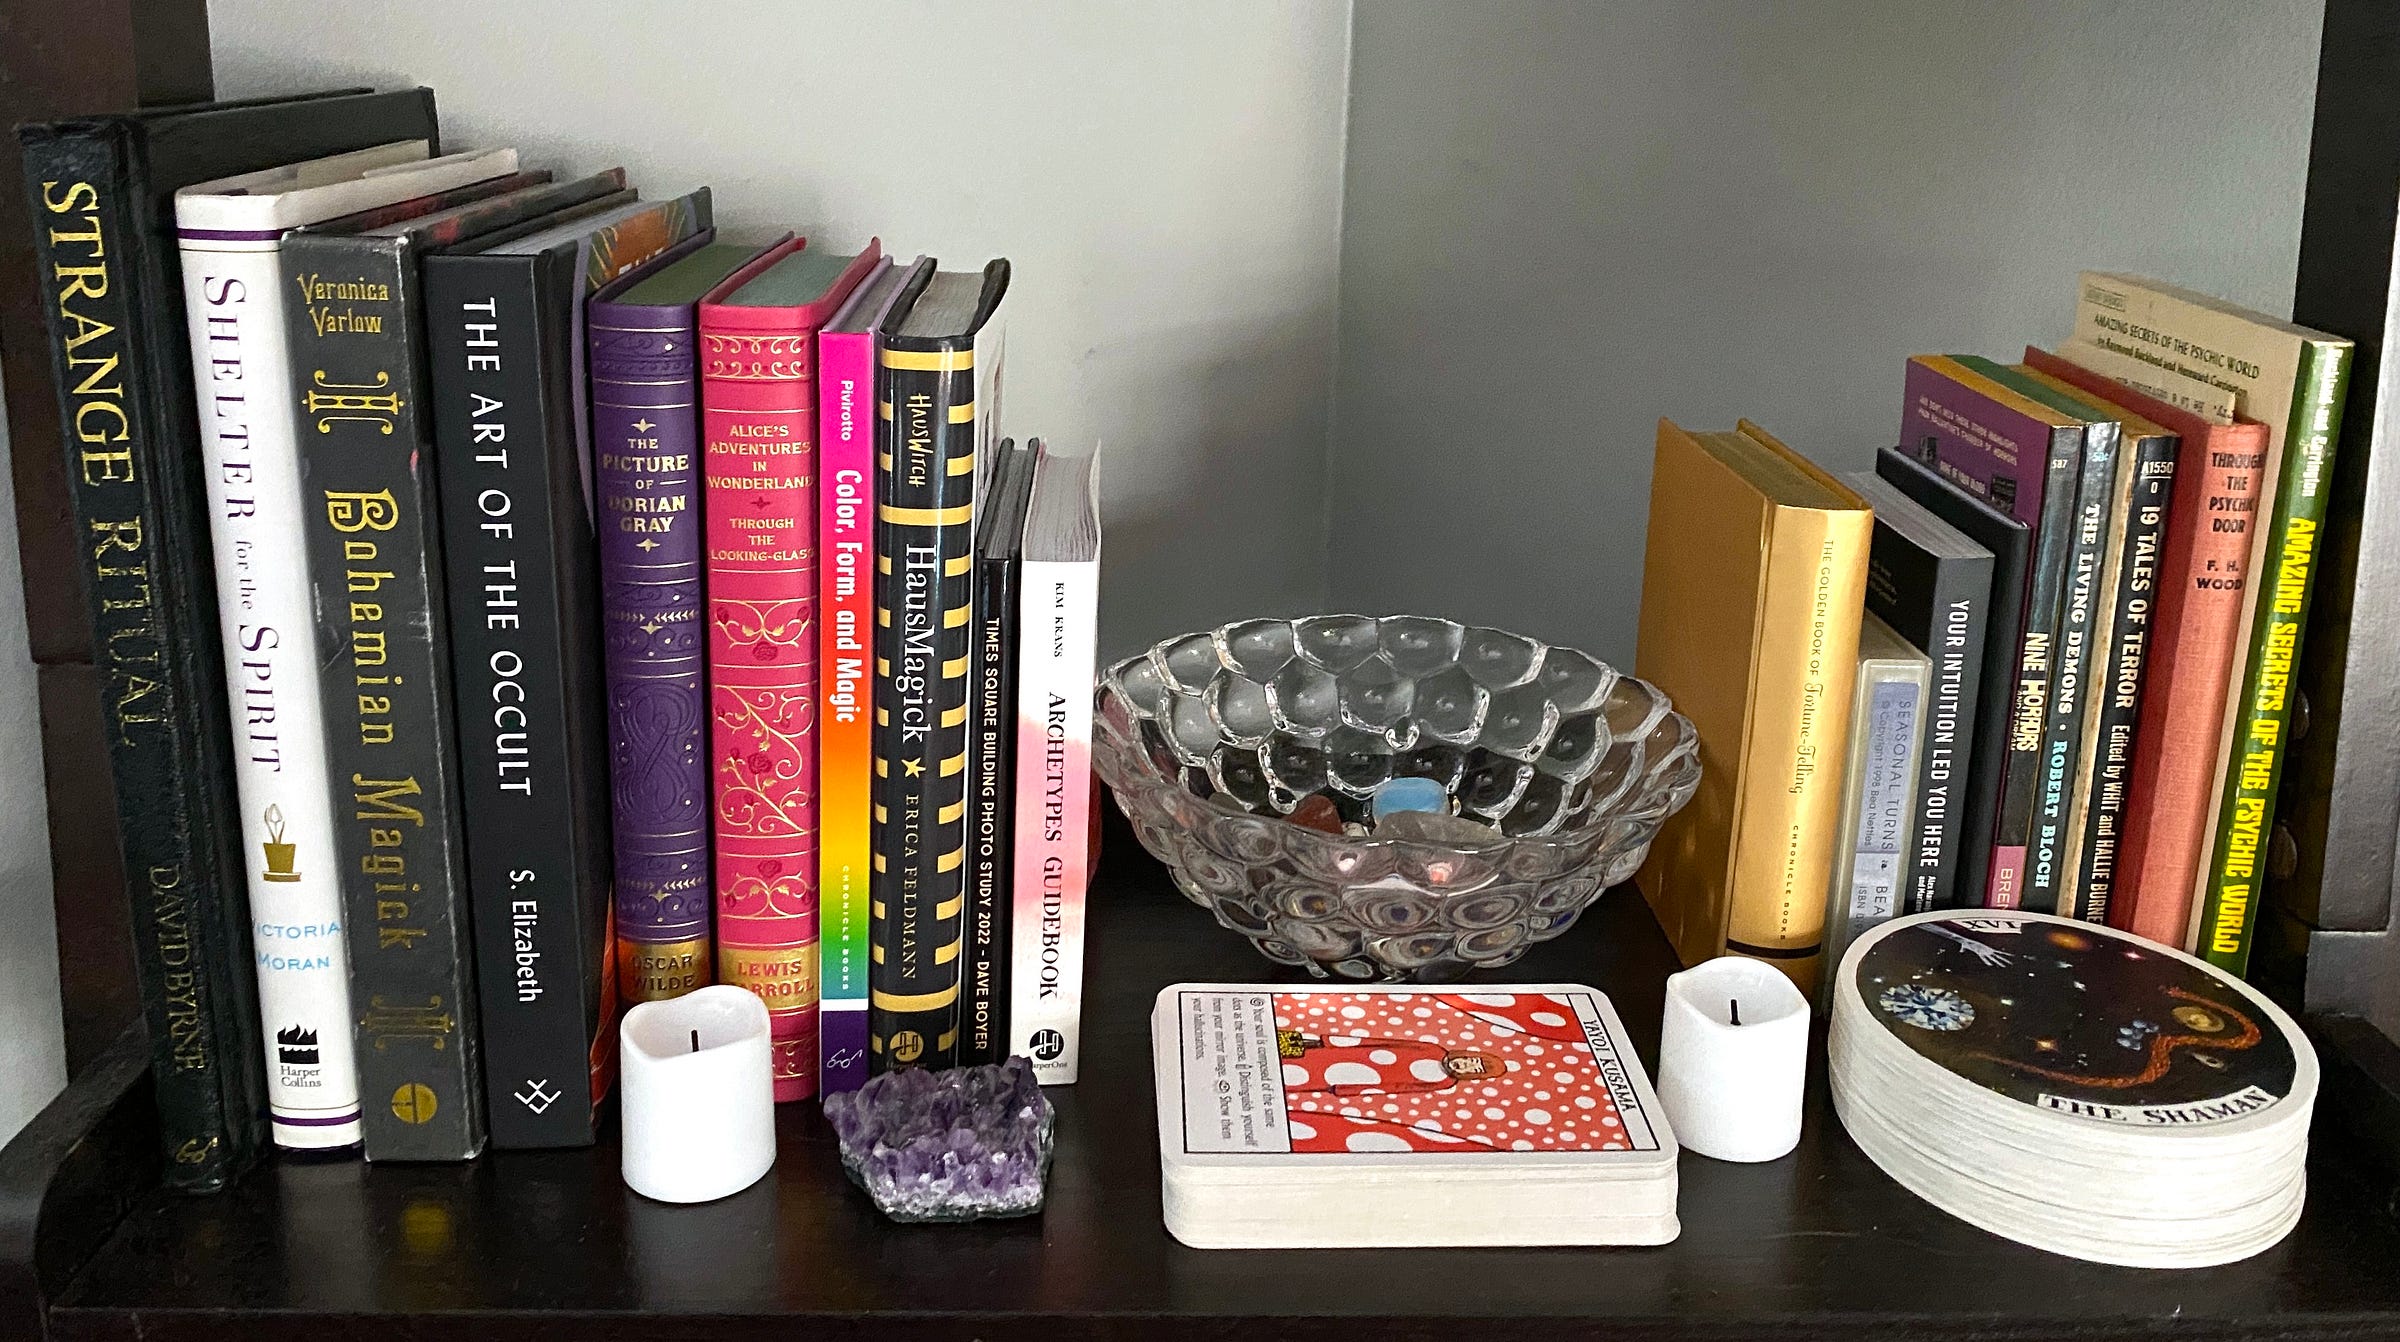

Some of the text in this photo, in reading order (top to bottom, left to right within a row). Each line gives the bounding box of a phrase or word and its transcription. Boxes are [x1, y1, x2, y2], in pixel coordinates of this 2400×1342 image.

[297, 273, 390, 304] Veronica
[309, 306, 382, 336] Varlow
[2094, 313, 2260, 379] AMAZING SECRETS OF THE PSYCHIC WORLD
[840, 380, 854, 441] Pivirotto
[627, 438, 658, 450] THE
[729, 425, 789, 437] ALICE'S
[43, 180, 165, 747] STRANGE RITUAL
[602, 454, 689, 473] PICTURE
[709, 441, 812, 456] ADVENTURES
[752, 461, 767, 472] IN
[2141, 461, 2174, 474] A1550
[635, 479, 654, 490] OF
[2227, 476, 2248, 490] THE
[607, 494, 686, 513] DORIAN
[204, 276, 281, 772] SHELTER for the SPIRIT
[620, 516, 675, 533] GRAY
[729, 518, 794, 529] THROUGH
[2213, 518, 2246, 533] DOOR
[463, 297, 531, 796] THE ART OF THE OCCULT
[747, 534, 775, 545] THE
[1823, 540, 1833, 562] THE
[2207, 560, 2239, 572] F. H.
[829, 469, 862, 723] Color, Form, and Magic
[1817, 567, 1831, 617] GOLDEN
[2196, 577, 2243, 590] WOOD
[1054, 582, 1064, 658] KIM KRANS
[2115, 505, 2161, 709] 19 TALES OF TERROR
[1811, 622, 1824, 655] BOOK
[1946, 600, 1970, 647] YOUR
[895, 544, 937, 743] HausMagick
[1810, 660, 1819, 676] OF
[1935, 653, 1964, 743] INTUITION
[2016, 632, 2050, 752] NINE HORRORS
[2035, 503, 2100, 888] THE LIVING DEMONS ROBERT BLOCH
[324, 488, 427, 950] Bohemian Magick
[2213, 517, 2316, 953] AMAZING SECRETS OF THE PSYCHIC WORLD
[1871, 766, 1883, 787] 1998
[1931, 750, 1952, 780] LED
[1868, 791, 1879, 809] Bea
[1873, 701, 1911, 915] SEASONAL TURNS BEA
[1926, 786, 1948, 819] YOU
[2092, 725, 2130, 879] Edited by WHIT and HALLIE
[975, 618, 999, 1050] TIMES SQUARE BUILDING PHOTO STUDY 2022 DAVE BOYER
[1039, 692, 1066, 1000] ARCHETYPES GUIDEBOOK
[1919, 824, 1943, 868] HERE
[1786, 825, 1799, 894] CHRONICLE
[902, 794, 919, 979] ERICA FELDMANN
[1857, 886, 1867, 908] ISBN
[257, 922, 341, 939] ICTORIA
[509, 869, 543, 1002] S. Elizabeth
[150, 864, 207, 1072] DAVID BYRNE
[258, 956, 330, 971] MORAN
[632, 954, 693, 971] OSCAR
[737, 960, 802, 977] LEWIS
[633, 974, 695, 994] WILDE
[280, 1065, 321, 1078] Harper
[1258, 1047, 1270, 1080] composed
[1583, 1019, 1637, 1111] YAYOI KUSAMA
[281, 1076, 322, 1088] Collins
[1238, 1071, 1254, 1110] Distinguish
[1261, 1083, 1273, 1091] of
[1219, 1095, 1232, 1115] Show
[1263, 1094, 1275, 1106] the
[2046, 1089, 2269, 1123] THE SHAMAN
[1222, 1119, 1232, 1138] them
[1240, 1115, 1257, 1145] yourself
